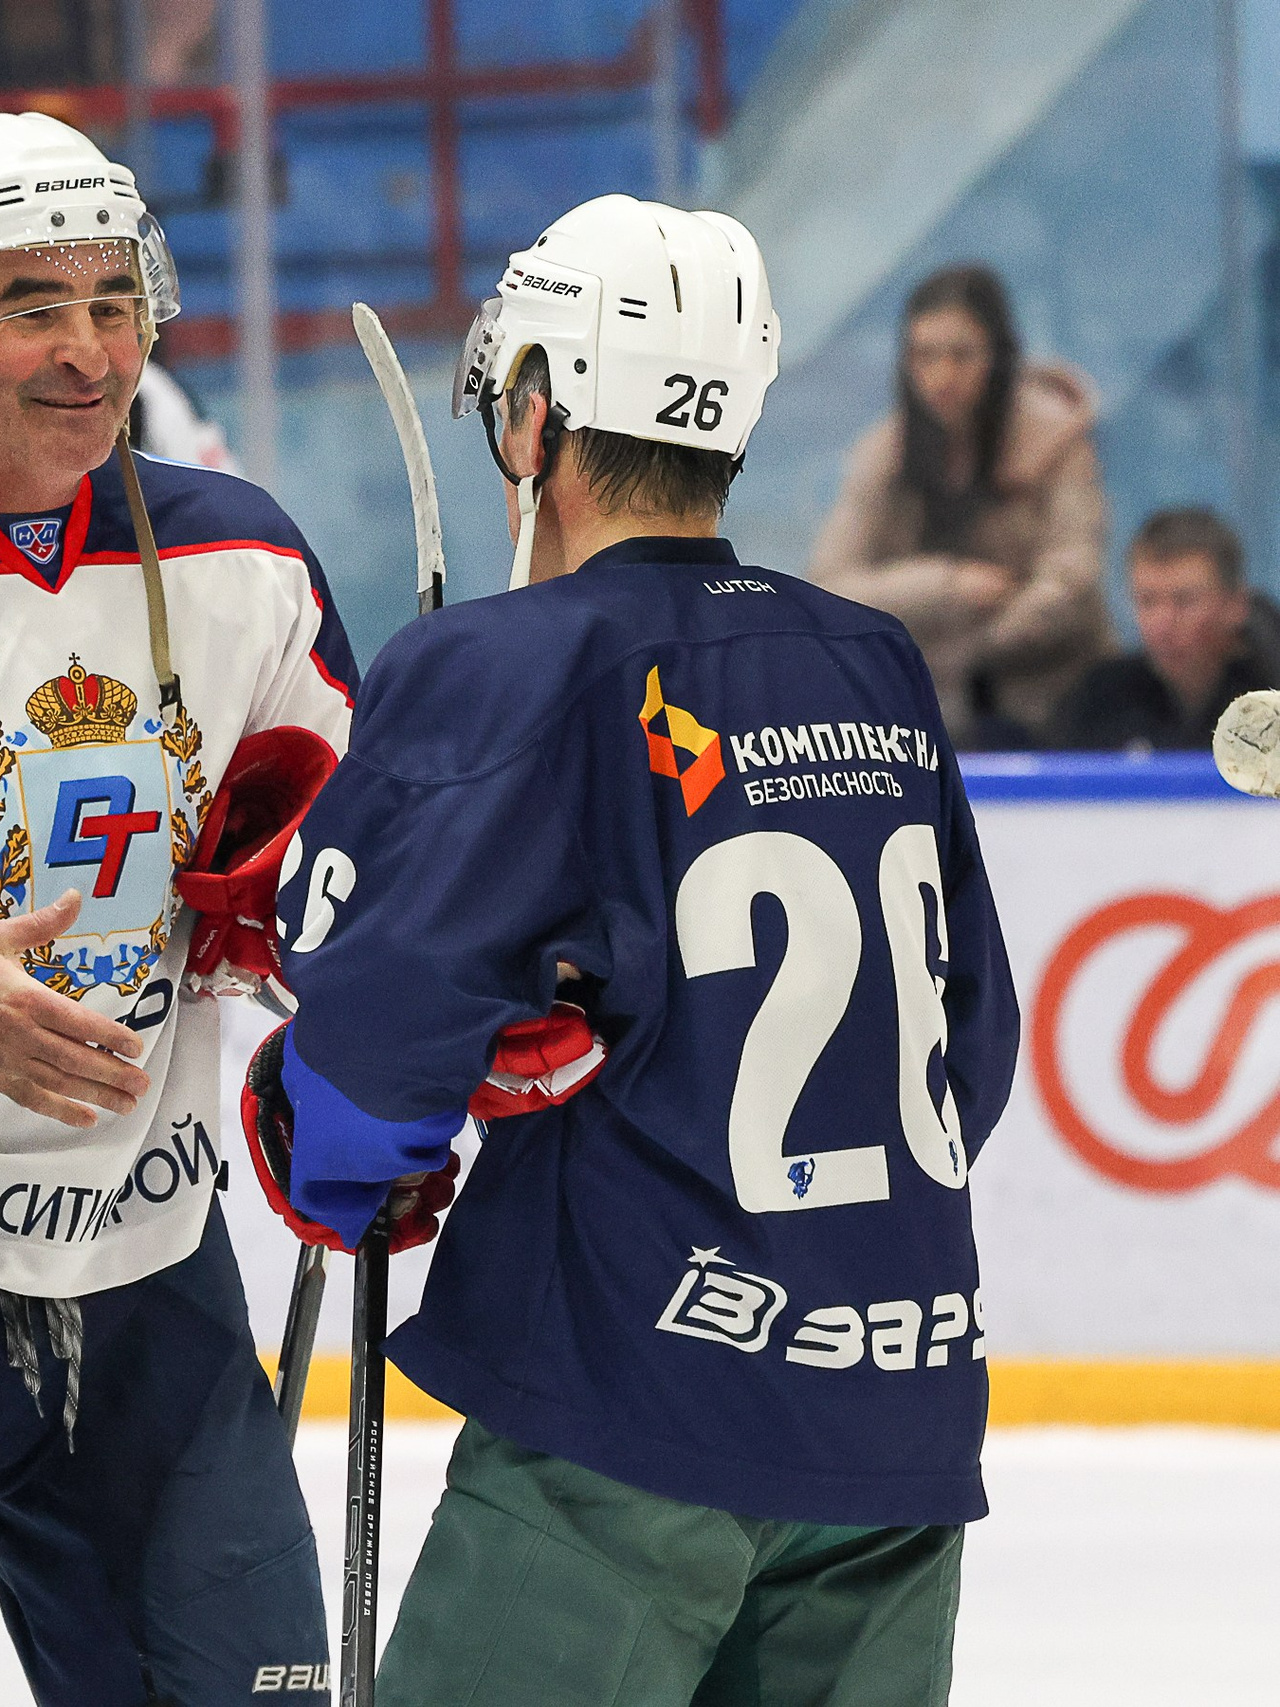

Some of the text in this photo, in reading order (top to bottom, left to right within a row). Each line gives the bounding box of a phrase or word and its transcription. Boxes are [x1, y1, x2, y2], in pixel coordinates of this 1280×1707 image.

[35, 177, 106, 193] BAUER
[522, 274, 583, 298] BAUER
[655, 373, 729, 431] 26
[703, 580, 777, 594] LUTCH
[743, 771, 904, 806] БЕЗОПАСНОСТЬ
[363, 1419, 378, 1616] РОССИЙСКОЕ ОРУЖИЕ ПОБЕД
[252, 1664, 331, 1694] BAU
